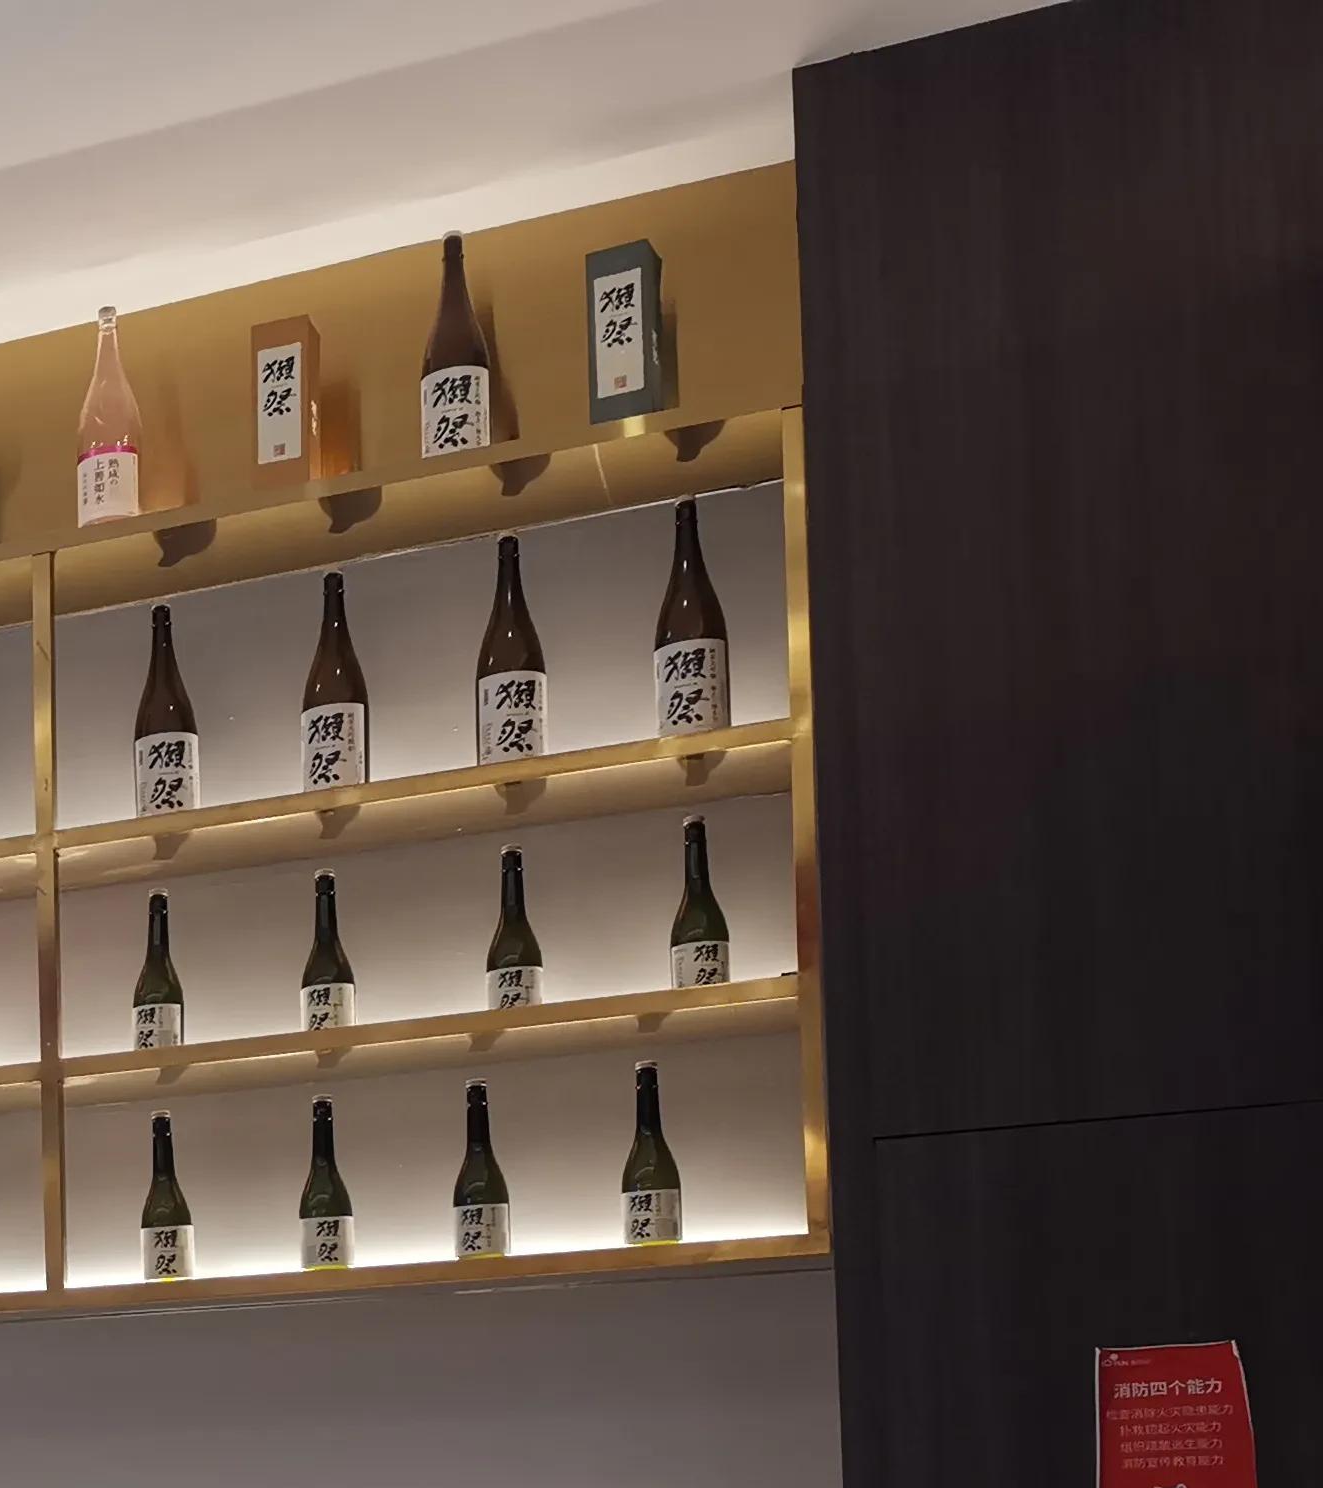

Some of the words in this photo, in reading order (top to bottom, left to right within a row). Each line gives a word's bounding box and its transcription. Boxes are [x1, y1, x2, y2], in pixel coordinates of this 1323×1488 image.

[1114, 1377, 1223, 1399] 消防四个能力
